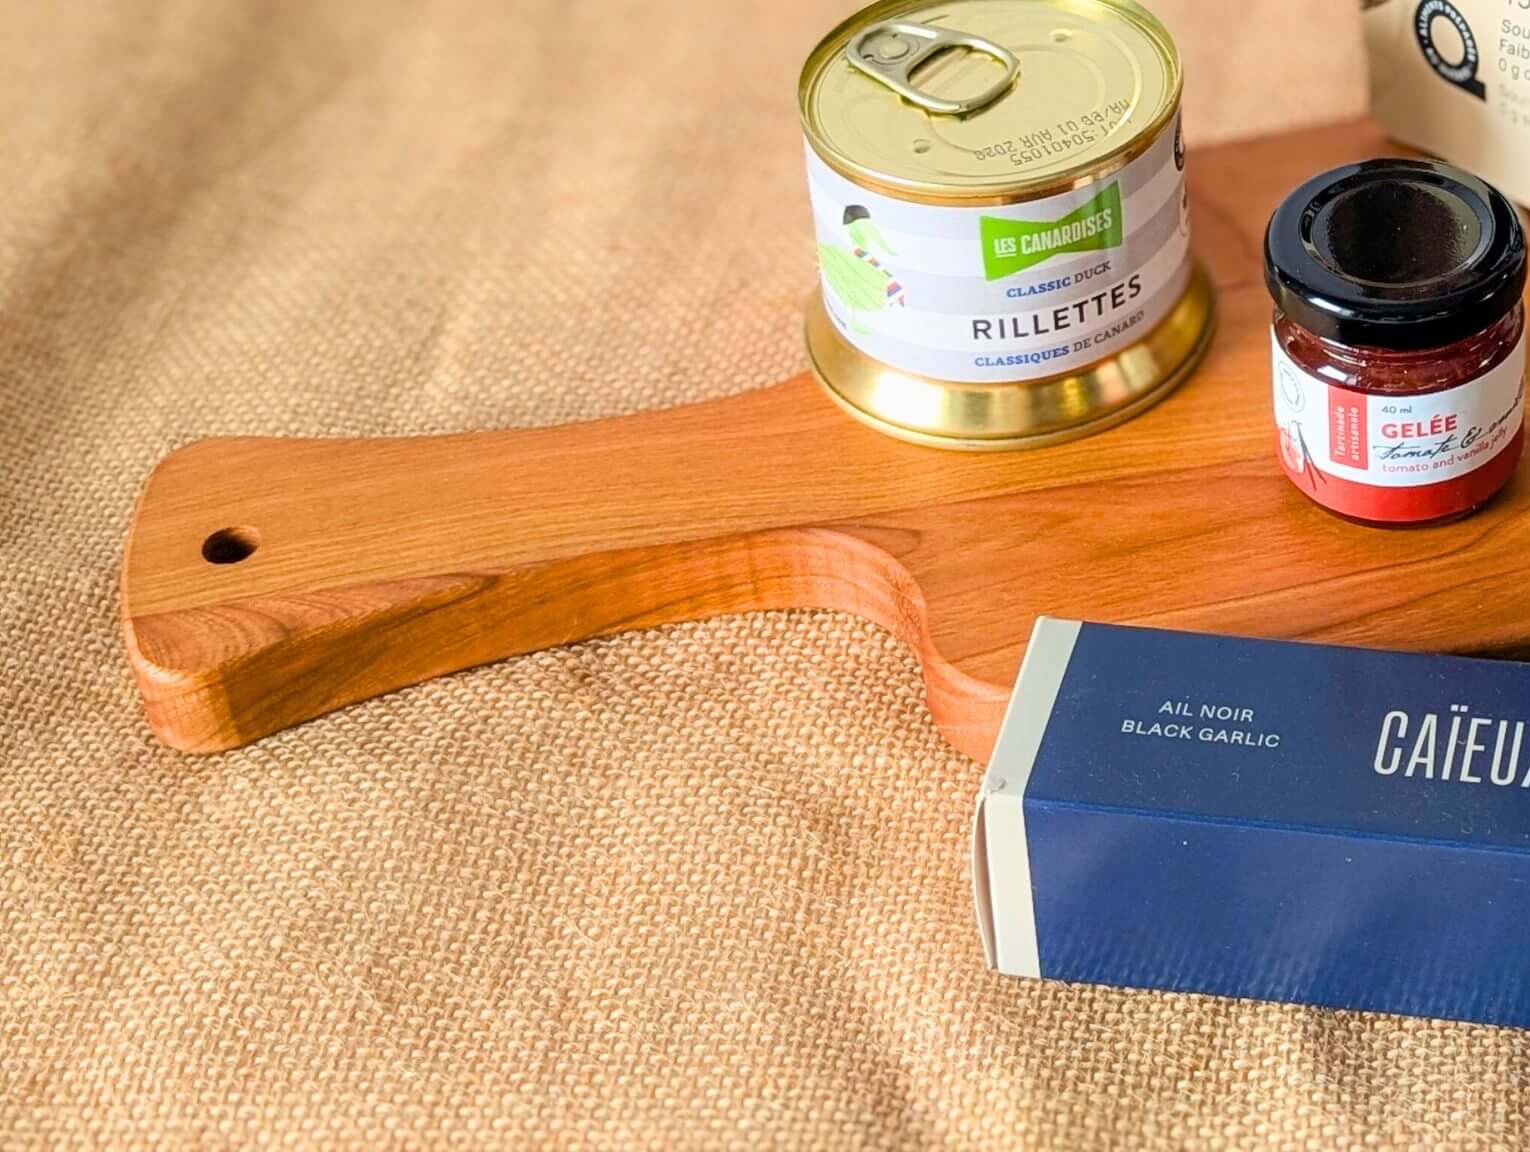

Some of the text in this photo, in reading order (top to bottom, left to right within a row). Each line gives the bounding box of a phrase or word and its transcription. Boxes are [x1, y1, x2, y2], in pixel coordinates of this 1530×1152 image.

[1511, 65, 1520, 81] g
[1018, 128, 1053, 149] AVR
[993, 208, 1112, 255] LES CANARDISES
[1006, 260, 1112, 298] CLASSIC DUCK
[972, 274, 1142, 340] RILLETTES
[975, 310, 1145, 367] CLASSIQUES DE CANARD
[1381, 404, 1413, 415] 40 ml
[1381, 413, 1458, 439] GELÉE
[1382, 462, 1429, 473] tomato
[1432, 454, 1455, 469] and
[1158, 700, 1255, 723] AIL NOIR
[1121, 719, 1280, 749] BLACK GARLIC
